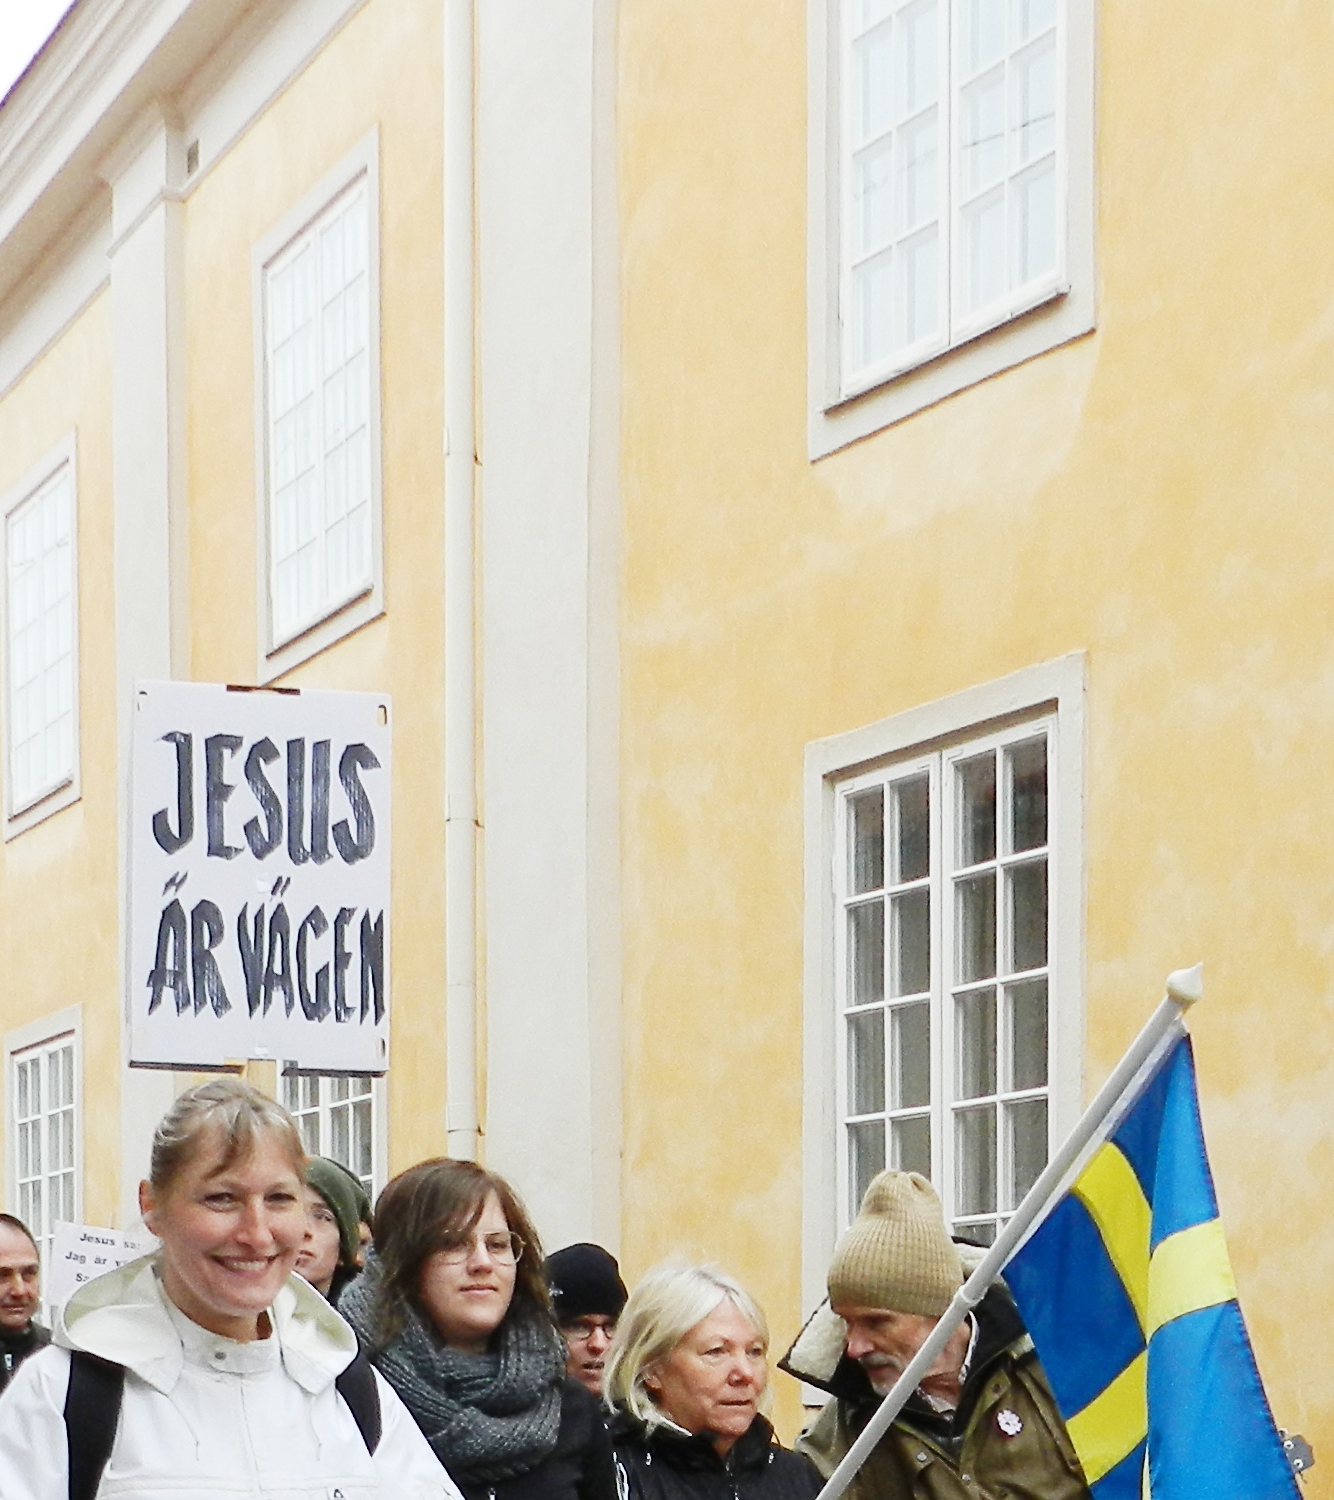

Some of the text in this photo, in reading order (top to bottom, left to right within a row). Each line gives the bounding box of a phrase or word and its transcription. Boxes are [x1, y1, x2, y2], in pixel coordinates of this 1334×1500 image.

[153, 731, 381, 866] JESUS
[146, 871, 385, 1026] ÄR VÄGEN
[65, 1251, 86, 1264] Jag
[80, 1233, 115, 1246] Jesus
